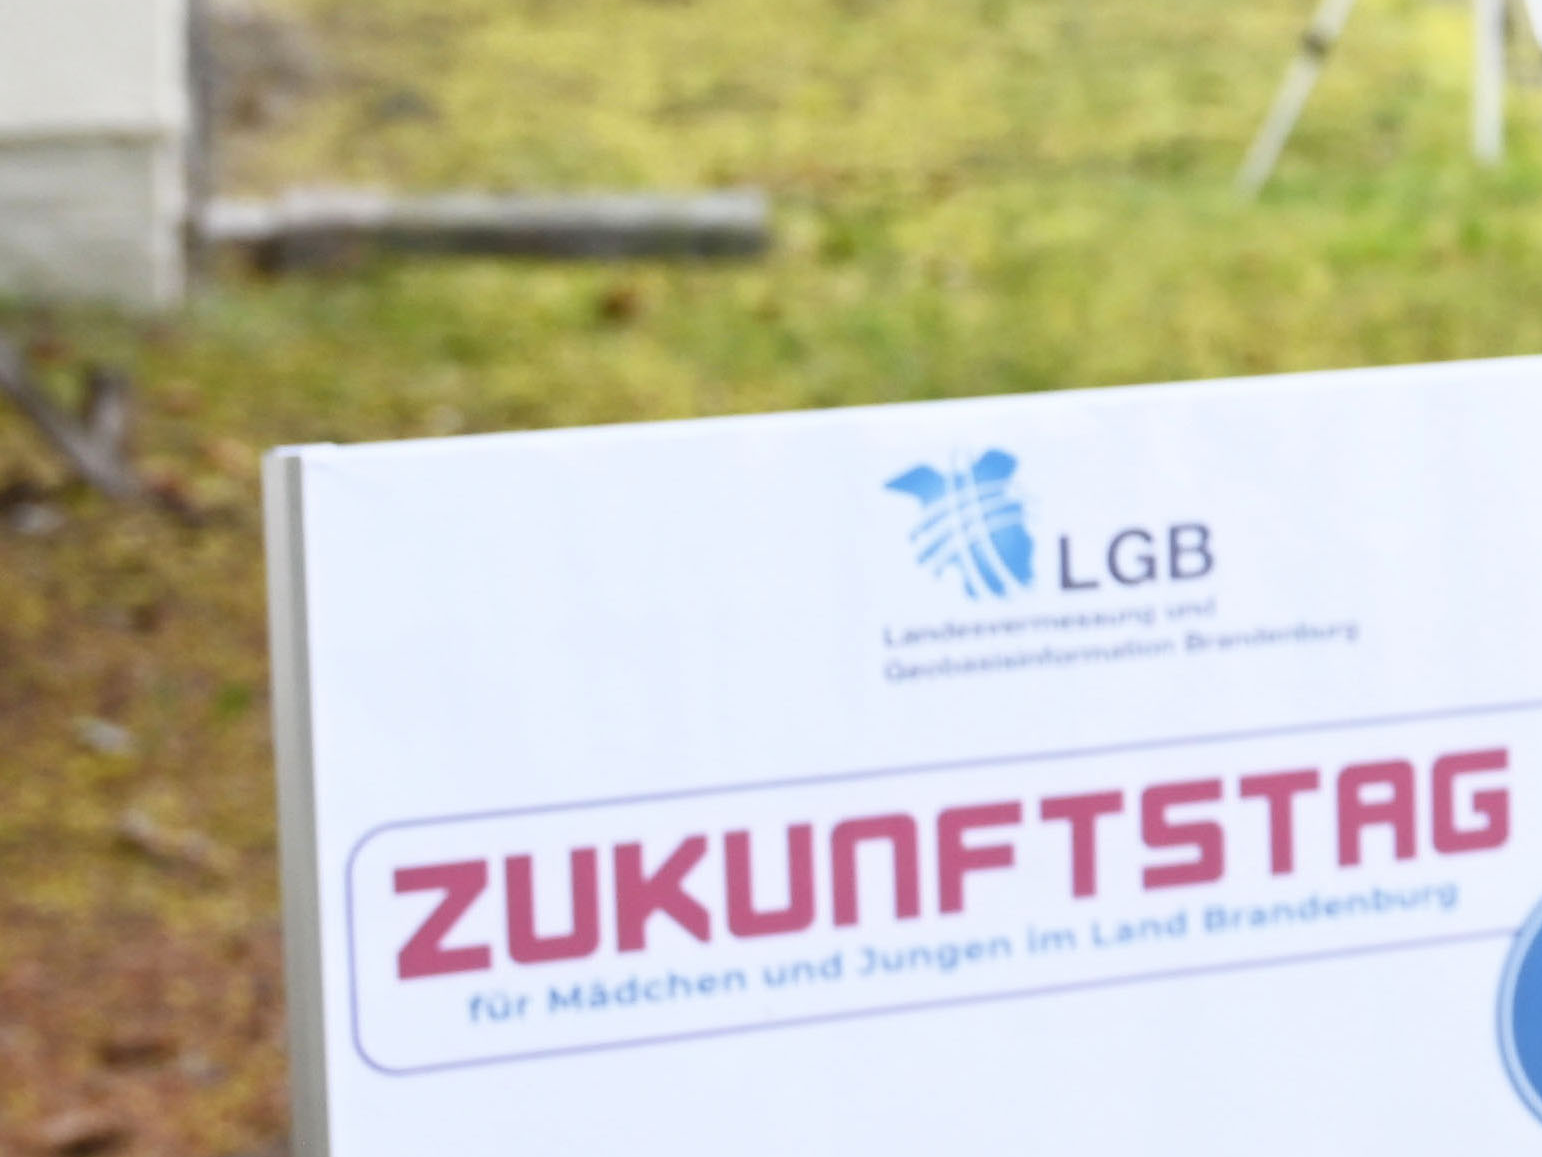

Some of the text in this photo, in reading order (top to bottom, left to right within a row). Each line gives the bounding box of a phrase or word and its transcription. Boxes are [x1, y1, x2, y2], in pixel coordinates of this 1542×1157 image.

[1059, 522, 1215, 591] LGB
[1165, 596, 1216, 622] und
[393, 746, 1510, 980] ZUKUNFTSTAG
[469, 882, 1459, 1024] für Mädchen und Jungen im Land Brandenburg
